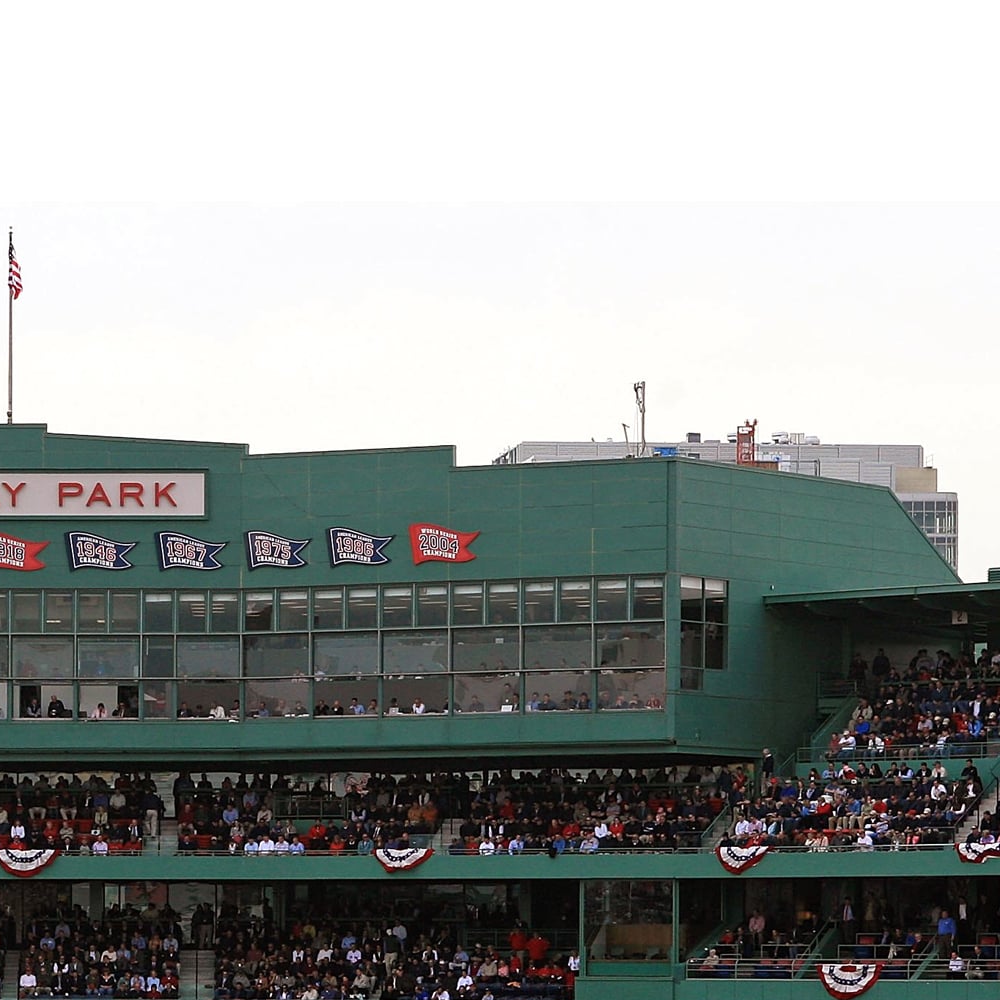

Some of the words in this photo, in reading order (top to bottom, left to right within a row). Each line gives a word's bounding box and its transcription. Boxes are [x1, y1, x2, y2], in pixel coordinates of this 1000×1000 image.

[58, 482, 178, 507] PARK
[76, 541, 117, 562] 1946
[166, 541, 206, 562] 1967
[254, 540, 291, 559] 1975
[336, 537, 374, 557] 1986
[419, 534, 459, 554] 2004
[80, 557, 114, 567] CHAMPIONS
[170, 557, 204, 567] CHAMPIONS
[257, 555, 288, 565] CHAMPIONS
[339, 552, 371, 562] CHAMPIONS
[423, 550, 456, 559] CHAMPIONS
